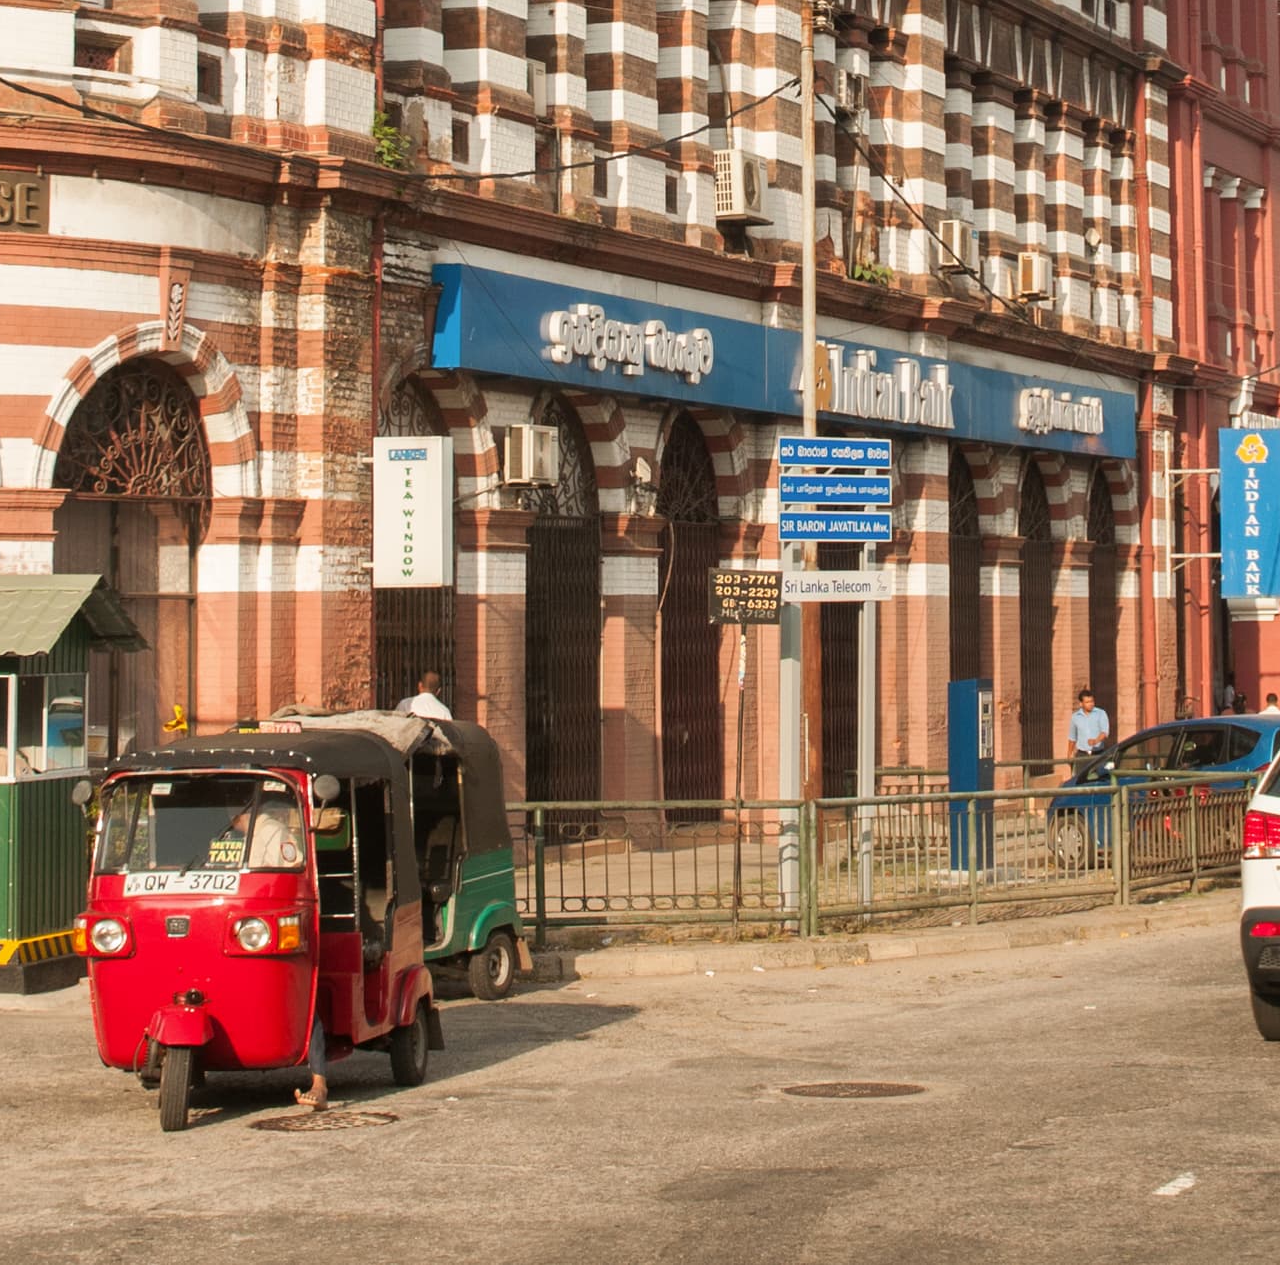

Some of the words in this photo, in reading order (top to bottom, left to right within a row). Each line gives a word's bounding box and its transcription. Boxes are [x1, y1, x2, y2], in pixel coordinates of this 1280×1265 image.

[827, 343, 900, 422] Indian
[894, 356, 955, 429] Bank
[1244, 467, 1260, 537] INDIAN
[782, 520, 795, 532] SIR
[797, 520, 826, 532] BARON
[828, 521, 872, 533] JAYATILKA
[402, 508, 415, 577] WINDOW
[1245, 549, 1260, 596] BANK
[715, 586, 779, 598] 203-2239
[784, 580, 798, 594] Sri
[800, 580, 829, 594] Lanka
[832, 580, 871, 593] Telecom
[211, 841, 242, 849] METER
[209, 850, 241, 862] TAXI
[144, 875, 169, 891] QW
[189, 874, 237, 891] 3702
